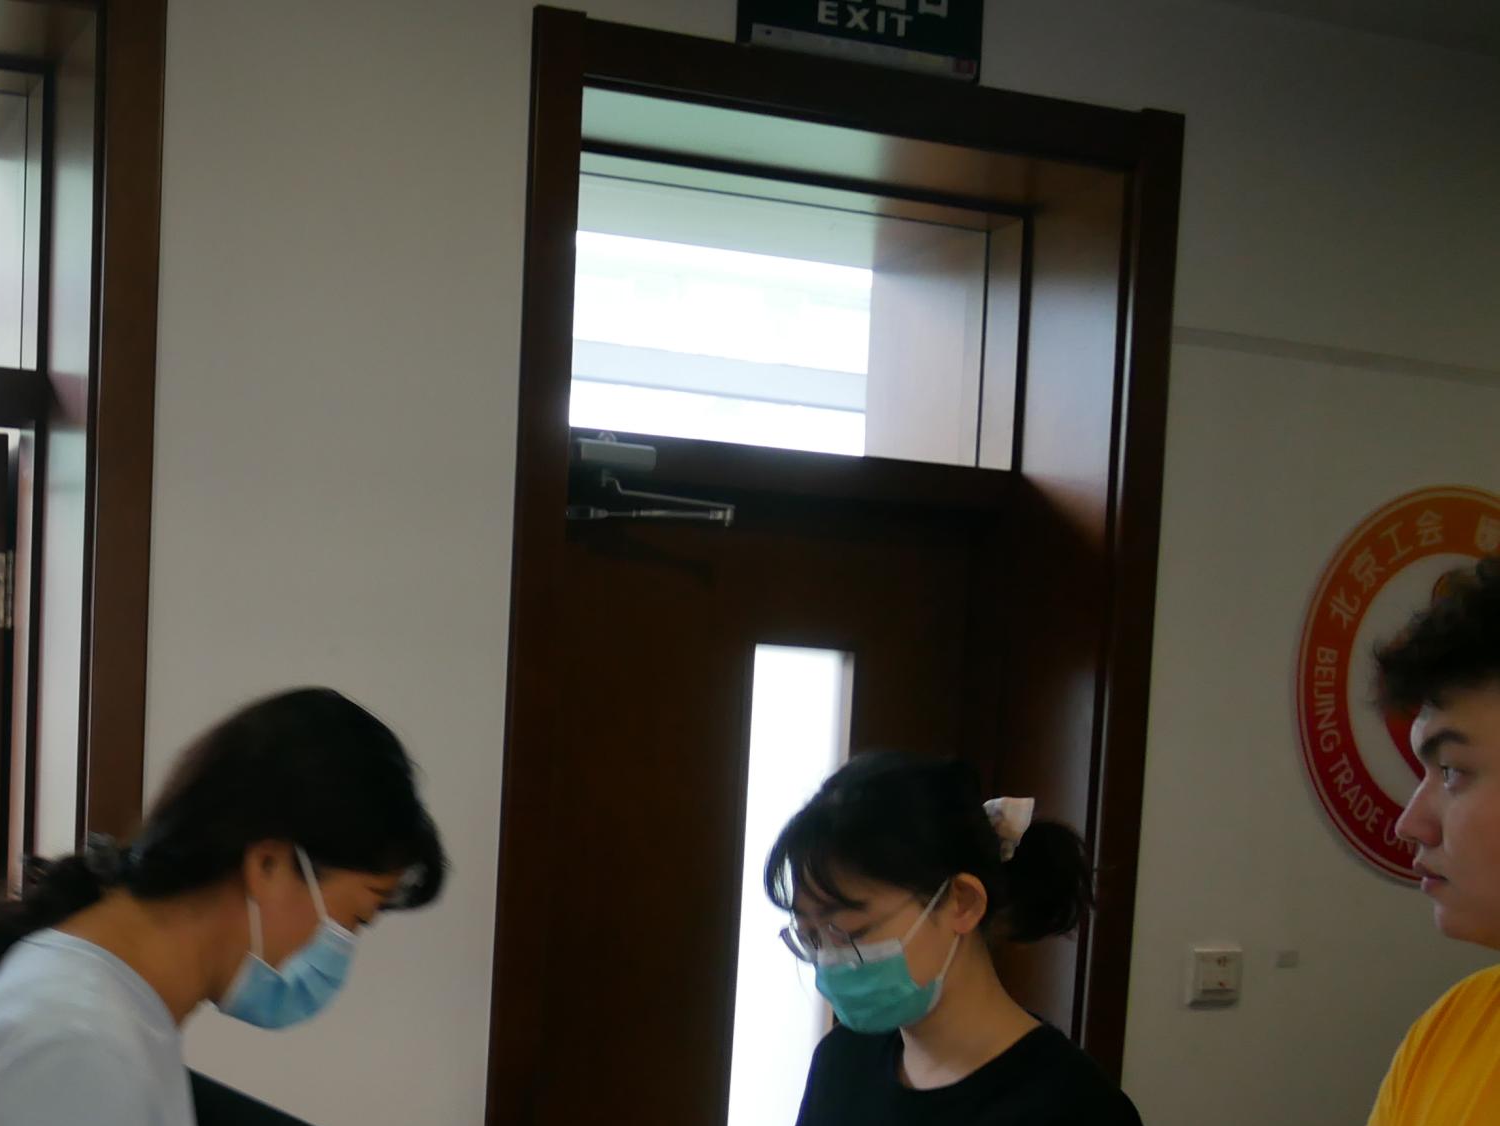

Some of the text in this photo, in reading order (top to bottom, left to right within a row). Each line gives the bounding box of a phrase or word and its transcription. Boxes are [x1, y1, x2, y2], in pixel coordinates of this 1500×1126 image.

[817, 0, 913, 38] EXIT
[1328, 509, 1445, 630] 北京工会
[1312, 644, 1342, 753] BEIJING
[1328, 753, 1384, 832] TRADE
